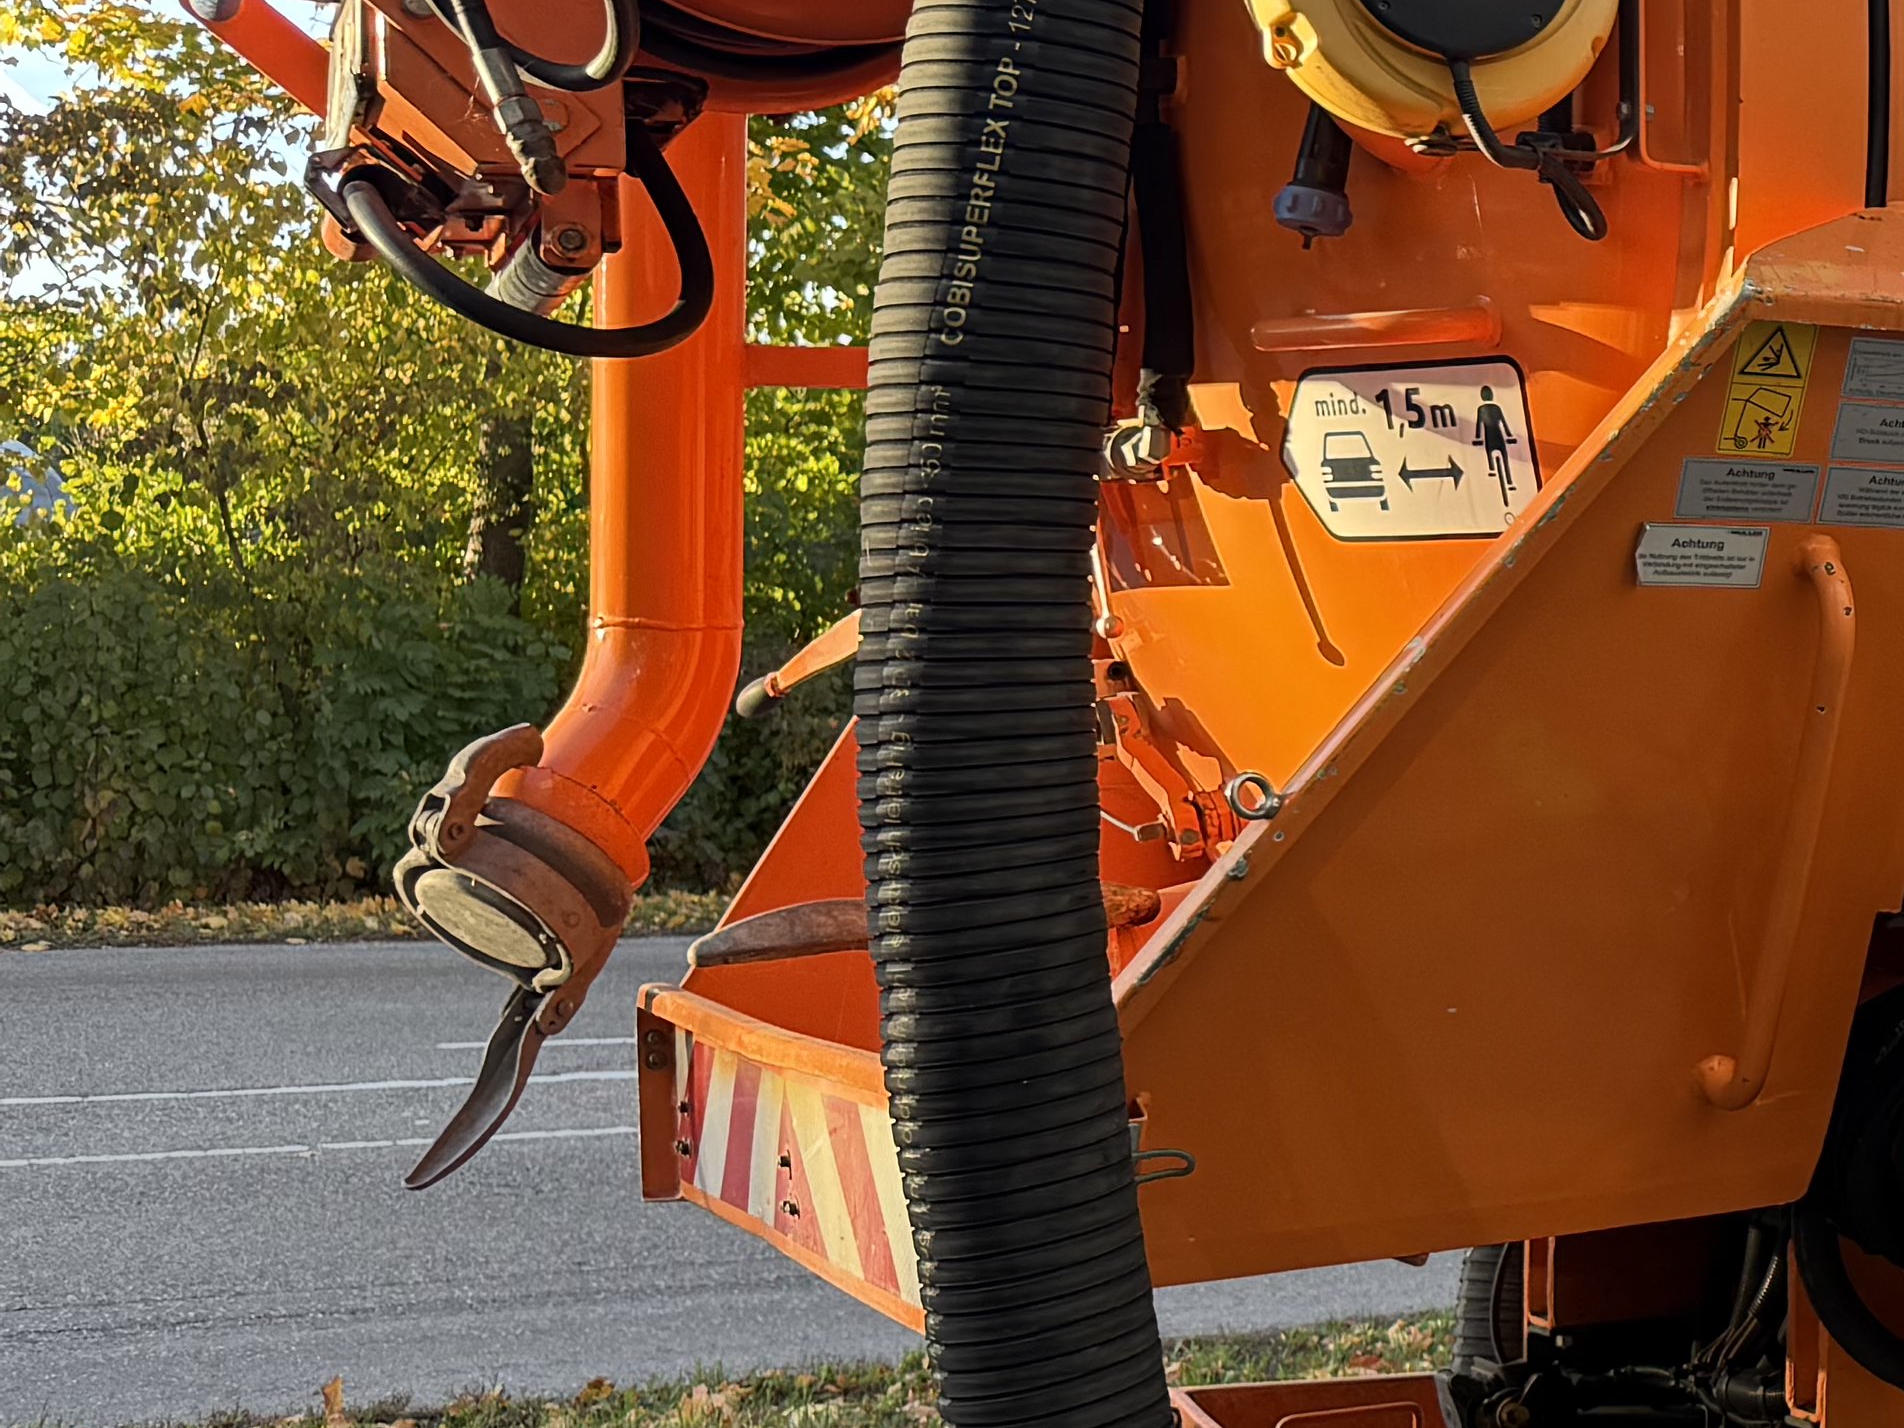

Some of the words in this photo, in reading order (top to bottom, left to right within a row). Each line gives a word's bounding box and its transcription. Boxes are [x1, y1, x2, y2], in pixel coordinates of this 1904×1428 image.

[940, 107, 1009, 346] COBISUPERFLEX
[989, 56, 1020, 111] TOP
[1315, 392, 1366, 417] mind.
[1727, 468, 1775, 481] Achtung
[1672, 538, 1725, 551] Achtung
